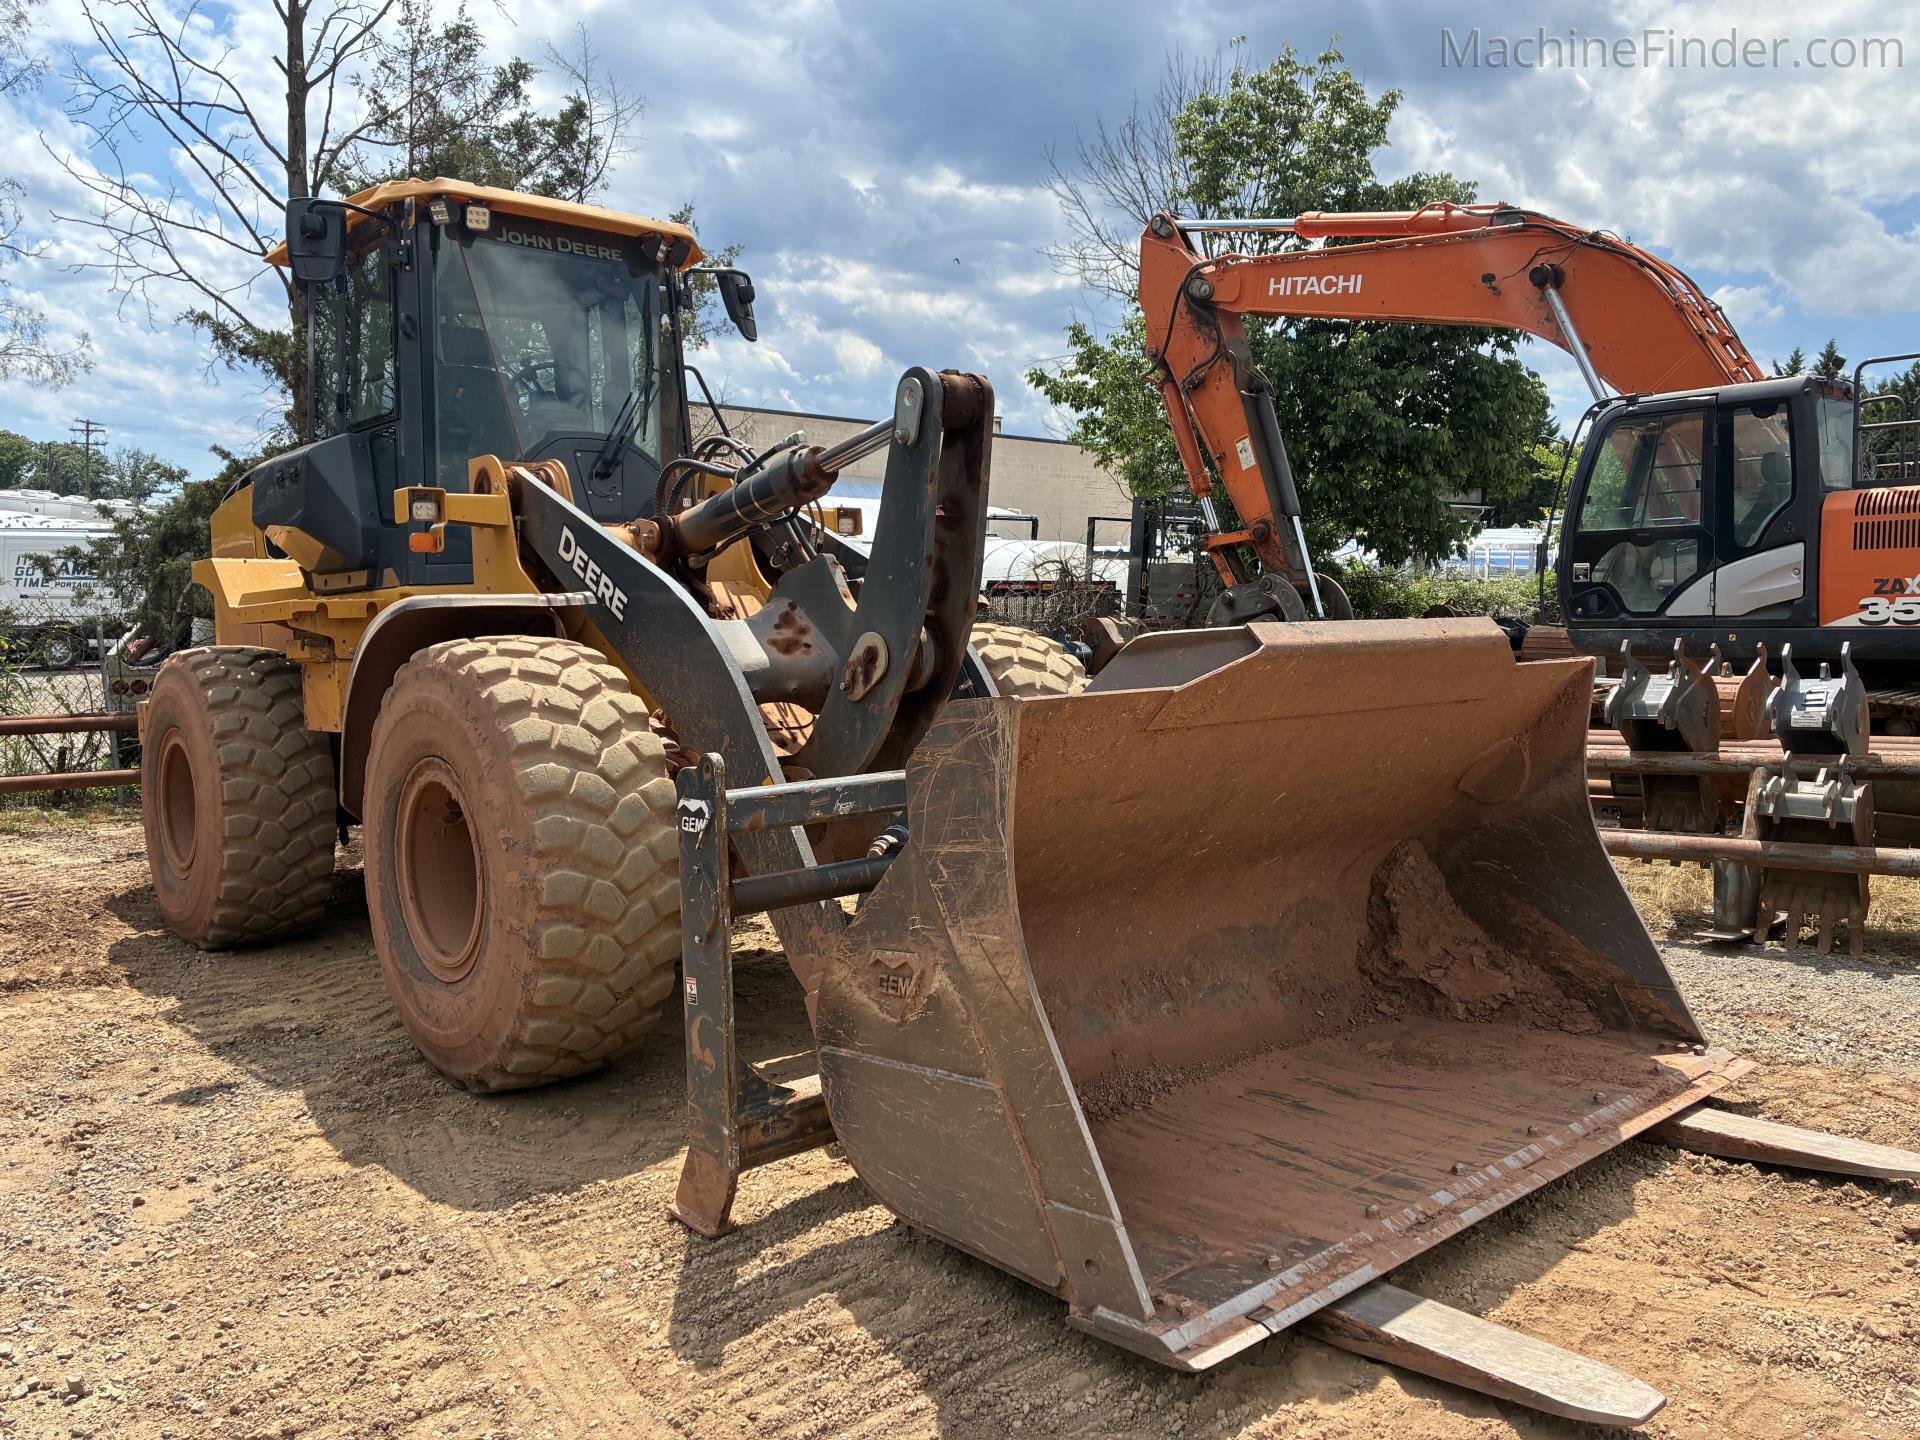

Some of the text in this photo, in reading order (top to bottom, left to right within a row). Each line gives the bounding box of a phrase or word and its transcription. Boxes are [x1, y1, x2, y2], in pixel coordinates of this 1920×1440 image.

[496, 226, 624, 262] JOHN DEERE
[1268, 274, 1363, 296] HITACHI
[13, 577, 50, 588] TIME
[14, 566, 36, 577] GO
[558, 525, 629, 622] DEERE
[681, 816, 707, 833] GEM
[879, 973, 914, 998] GEM
